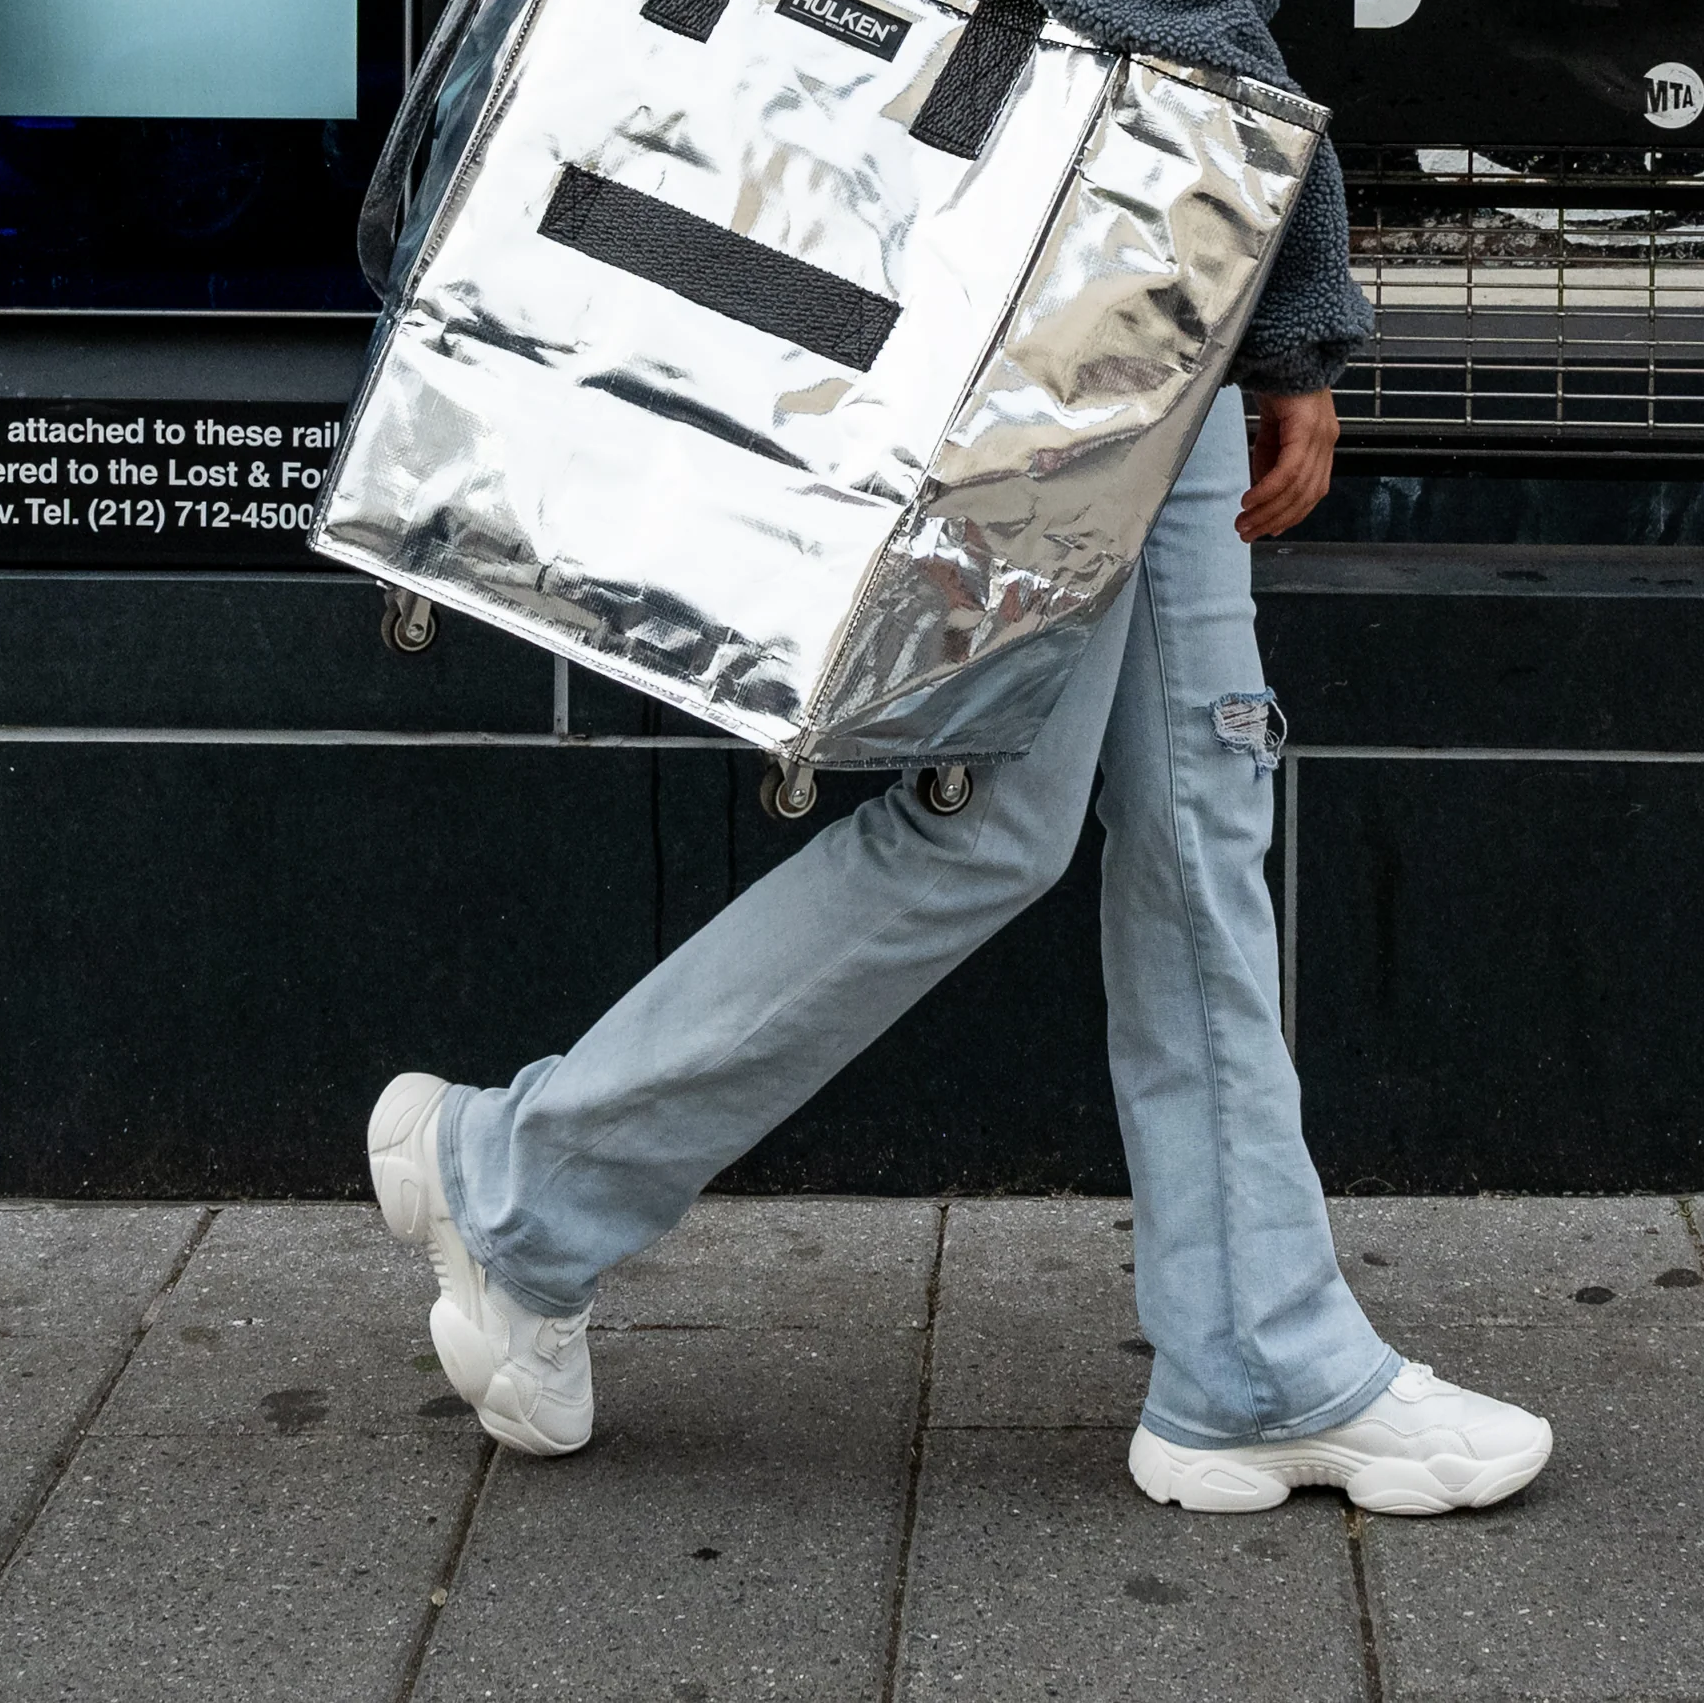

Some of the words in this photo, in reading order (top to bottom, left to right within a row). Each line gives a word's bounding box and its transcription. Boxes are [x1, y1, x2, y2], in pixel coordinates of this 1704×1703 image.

[1645, 77, 1694, 114] MTA
[7, 417, 144, 444] attached
[154, 420, 186, 445] to
[194, 419, 283, 447] these
[67, 459, 99, 485] to
[107, 458, 158, 486] the
[169, 459, 238, 487] Lost
[247, 461, 270, 488] &
[24, 498, 79, 526] Tel.
[88, 498, 166, 533] (212)
[174, 500, 315, 530] 712-4500
